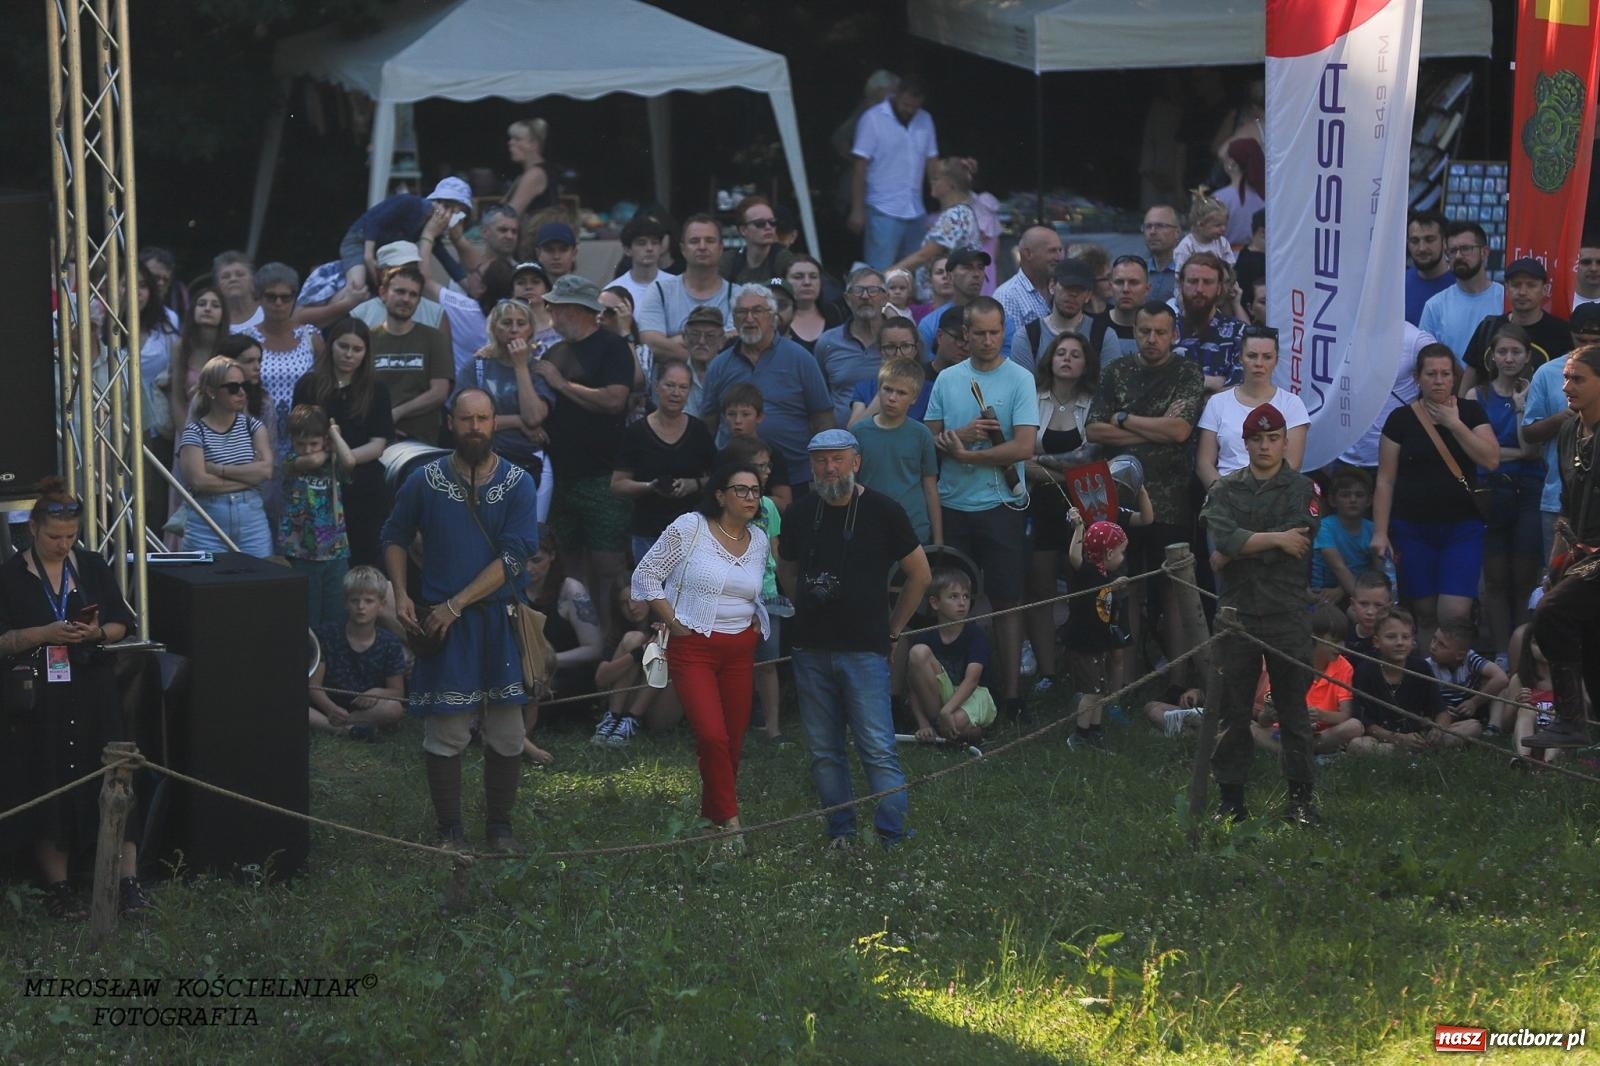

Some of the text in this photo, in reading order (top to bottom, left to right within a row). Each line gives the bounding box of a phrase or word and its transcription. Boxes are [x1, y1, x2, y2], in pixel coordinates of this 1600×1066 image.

[1374, 34, 1390, 140] 94.9 FM
[1308, 62, 1348, 417] VANESSA
[1290, 288, 1305, 396] RADIO
[1339, 375, 1352, 428] 95.8
